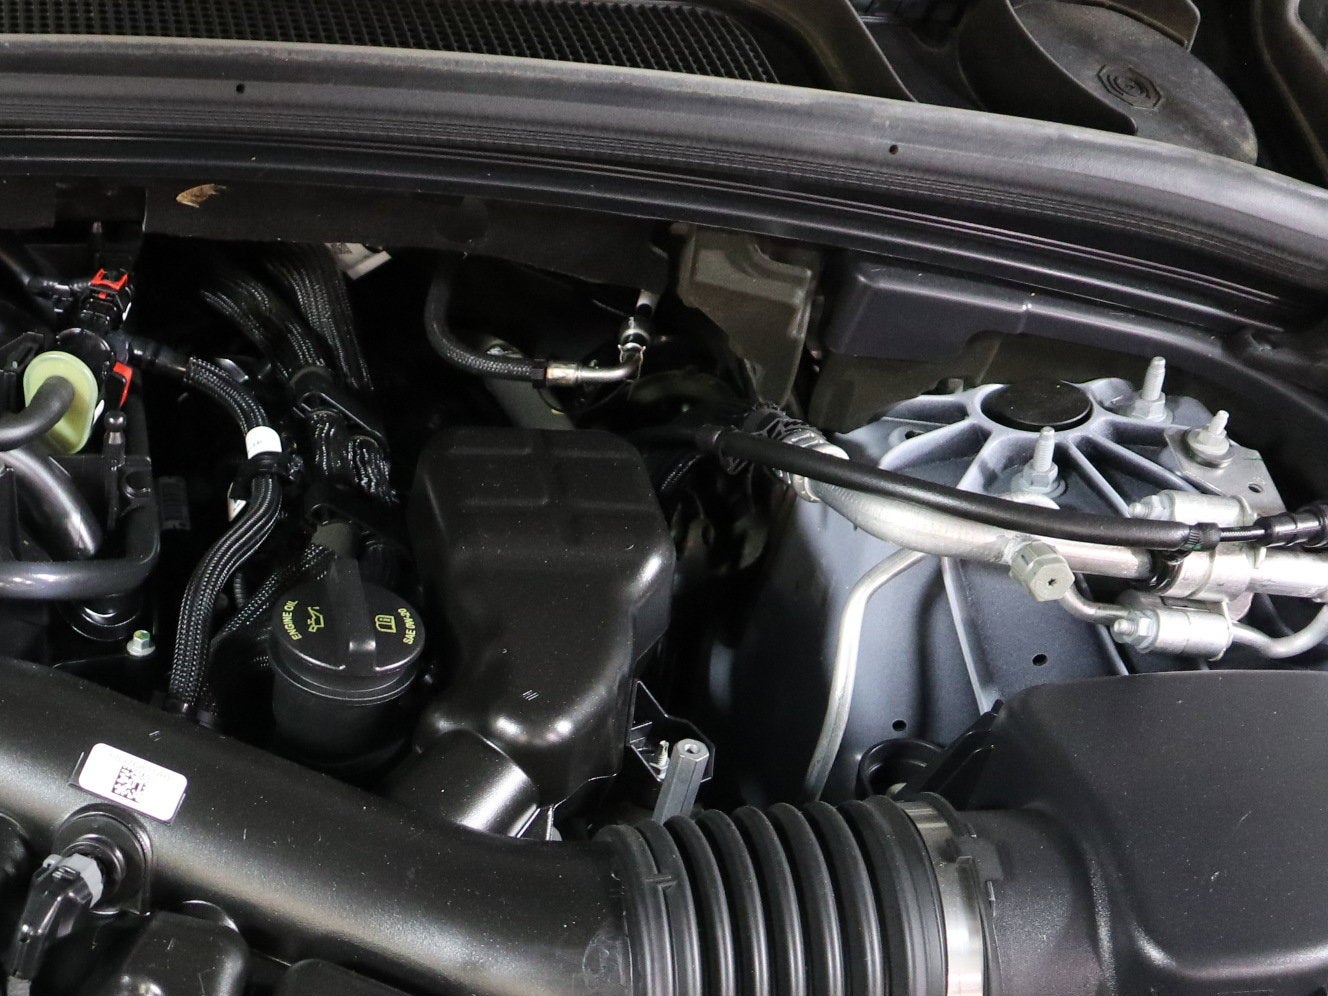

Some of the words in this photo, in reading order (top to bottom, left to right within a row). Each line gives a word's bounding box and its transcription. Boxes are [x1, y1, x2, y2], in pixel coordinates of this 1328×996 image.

[284, 600, 298, 612] OIL
[282, 612, 302, 640] ENGINE
[403, 628, 416, 645] SAE
